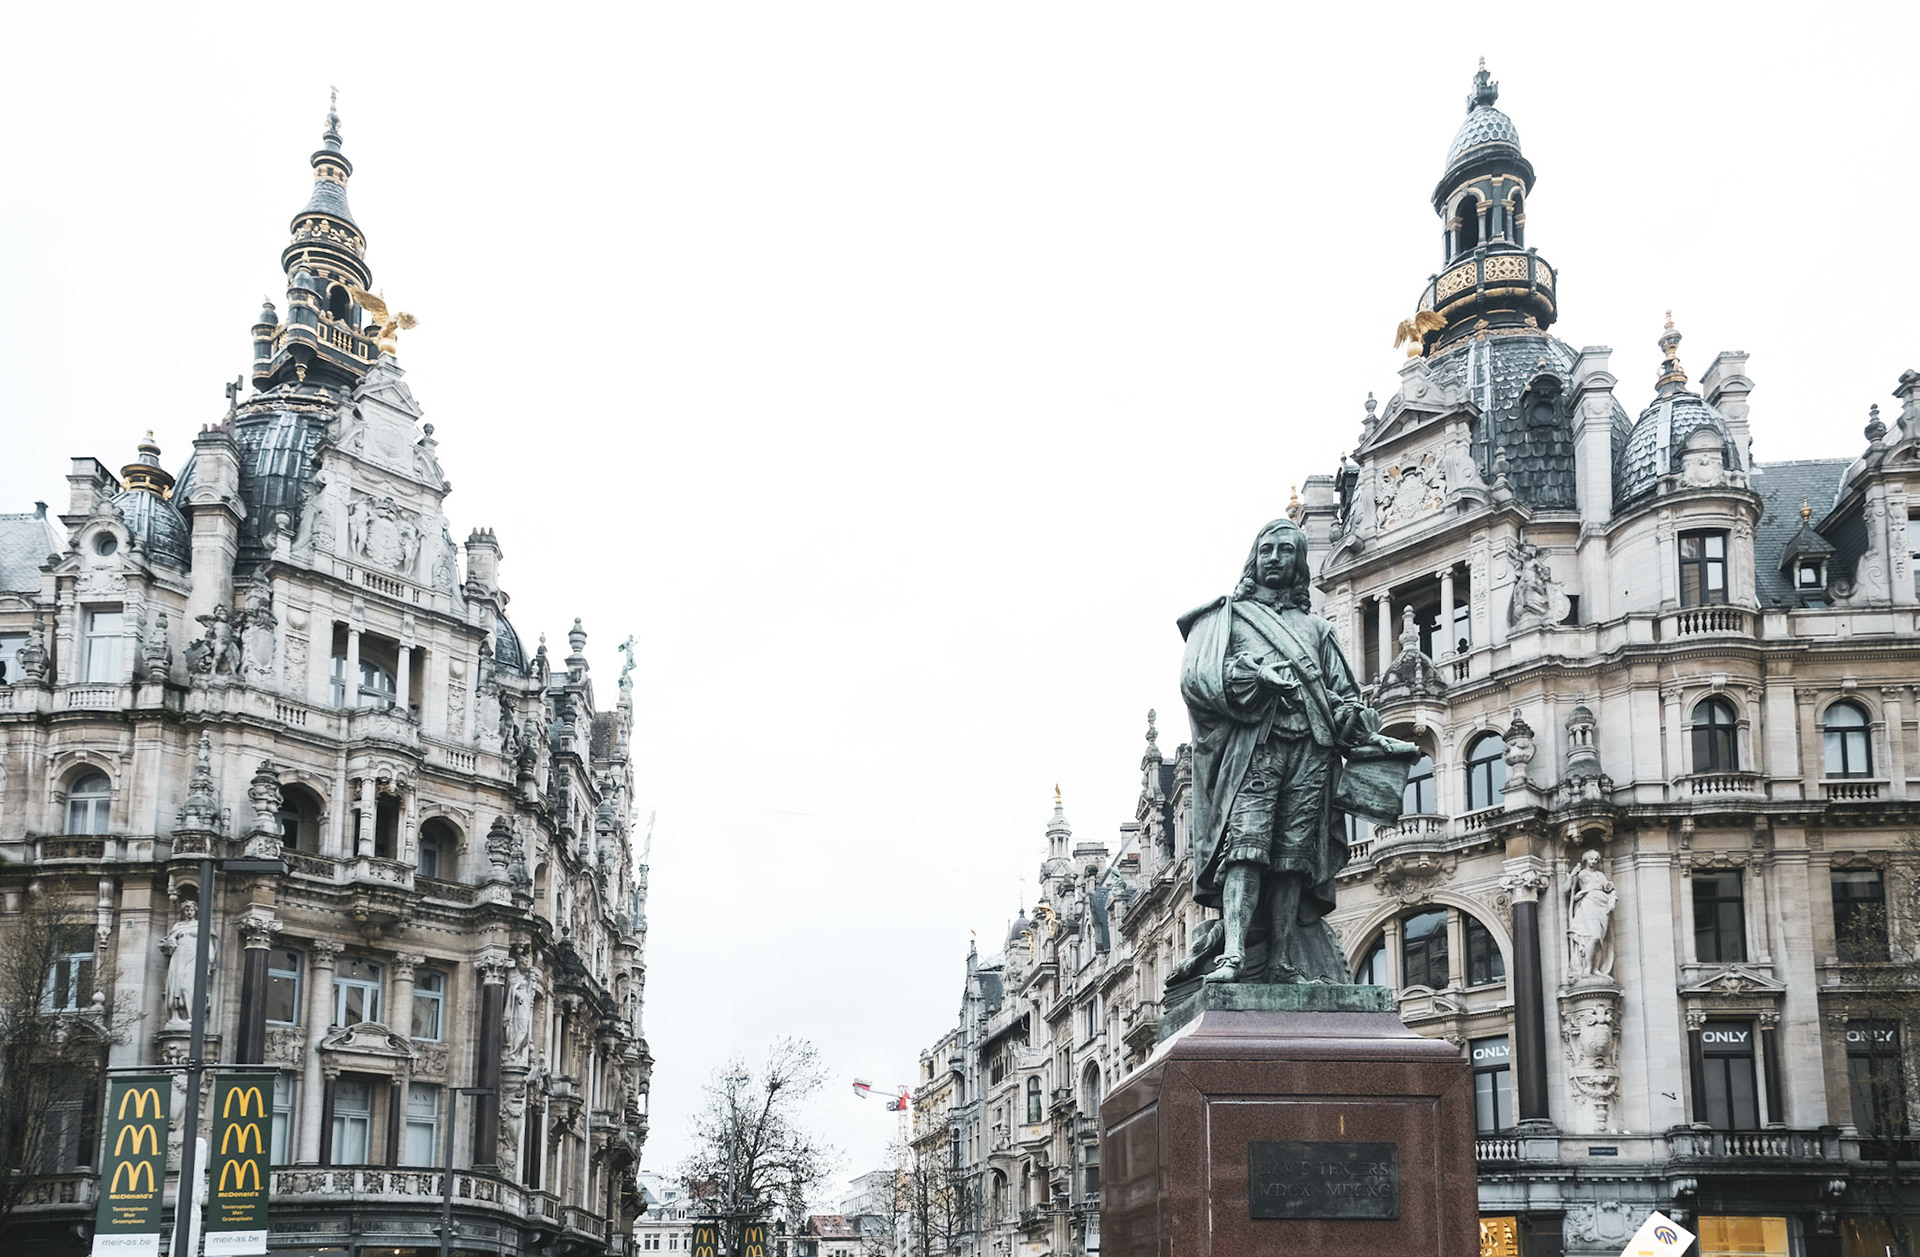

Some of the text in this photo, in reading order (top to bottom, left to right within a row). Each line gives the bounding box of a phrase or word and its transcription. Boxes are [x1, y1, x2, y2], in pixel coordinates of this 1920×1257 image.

[1702, 1031, 1748, 1043] ONLY
[1473, 1045, 1510, 1060] ONLY
[101, 1238, 152, 1247] meir-as.be
[212, 1235, 260, 1244] meir-as.be
